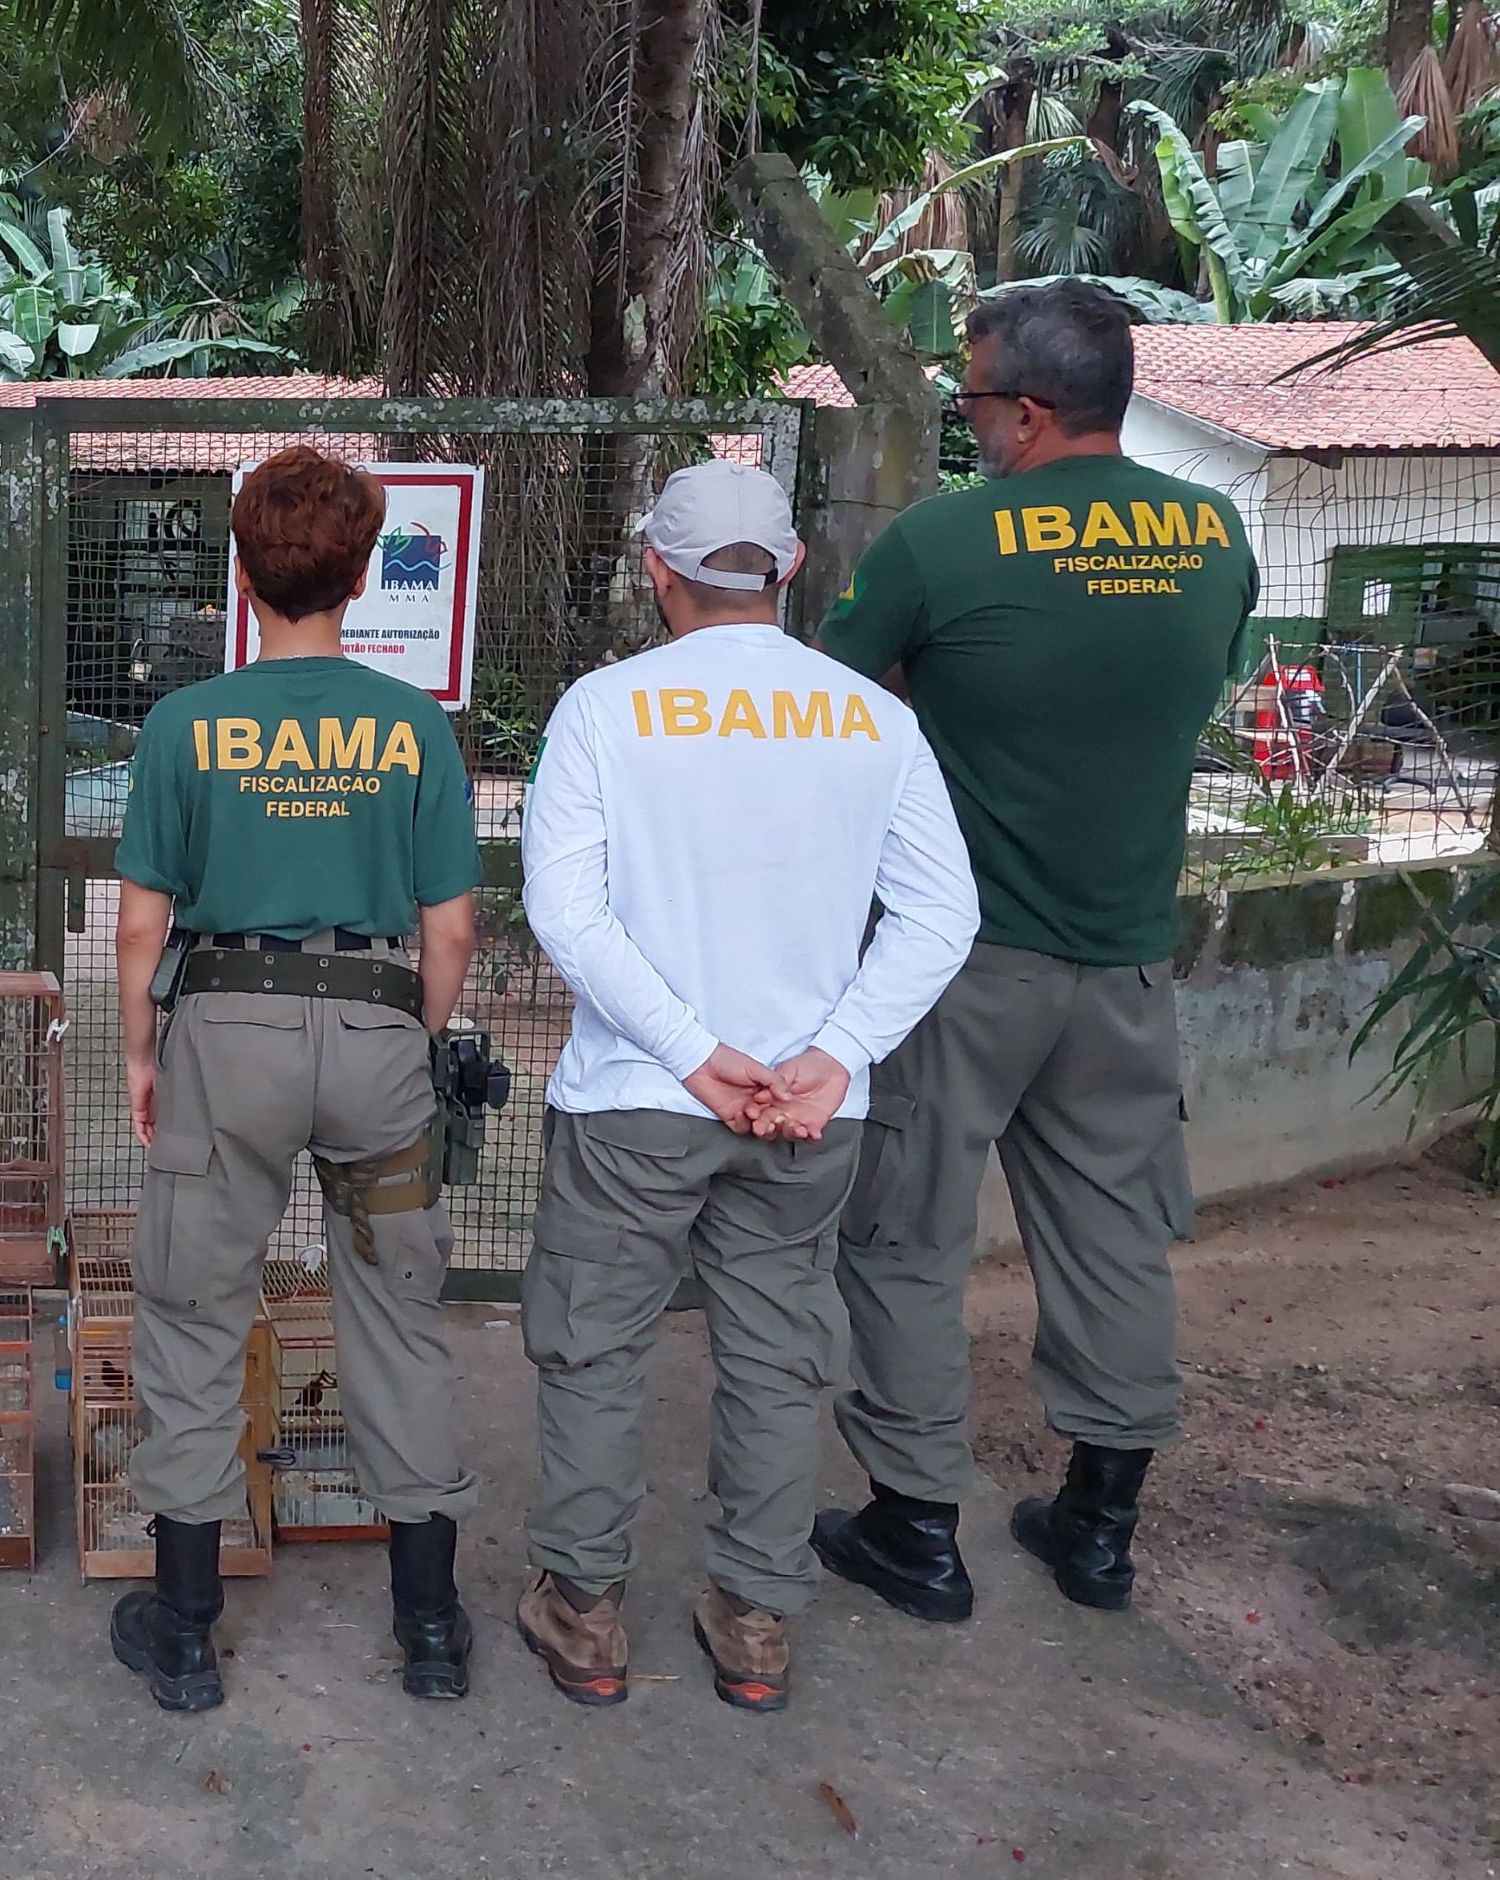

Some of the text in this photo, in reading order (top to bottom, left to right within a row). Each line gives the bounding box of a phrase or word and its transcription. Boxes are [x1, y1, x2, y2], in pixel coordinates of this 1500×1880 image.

[994, 501, 1231, 555] IBAMA
[1054, 552, 1204, 574] FISCALIZAÇÃO
[384, 579, 435, 592] IBAMA
[1086, 578, 1182, 595] FEDERAL
[381, 629, 440, 640] AUTORIZAÇÃO
[367, 644, 405, 654] FECHADO
[631, 688, 882, 742] IBAMA
[192, 717, 421, 776] IBAMA
[239, 773, 381, 796] FISCALIZAÇÃO
[265, 801, 350, 818] FEDERAL
